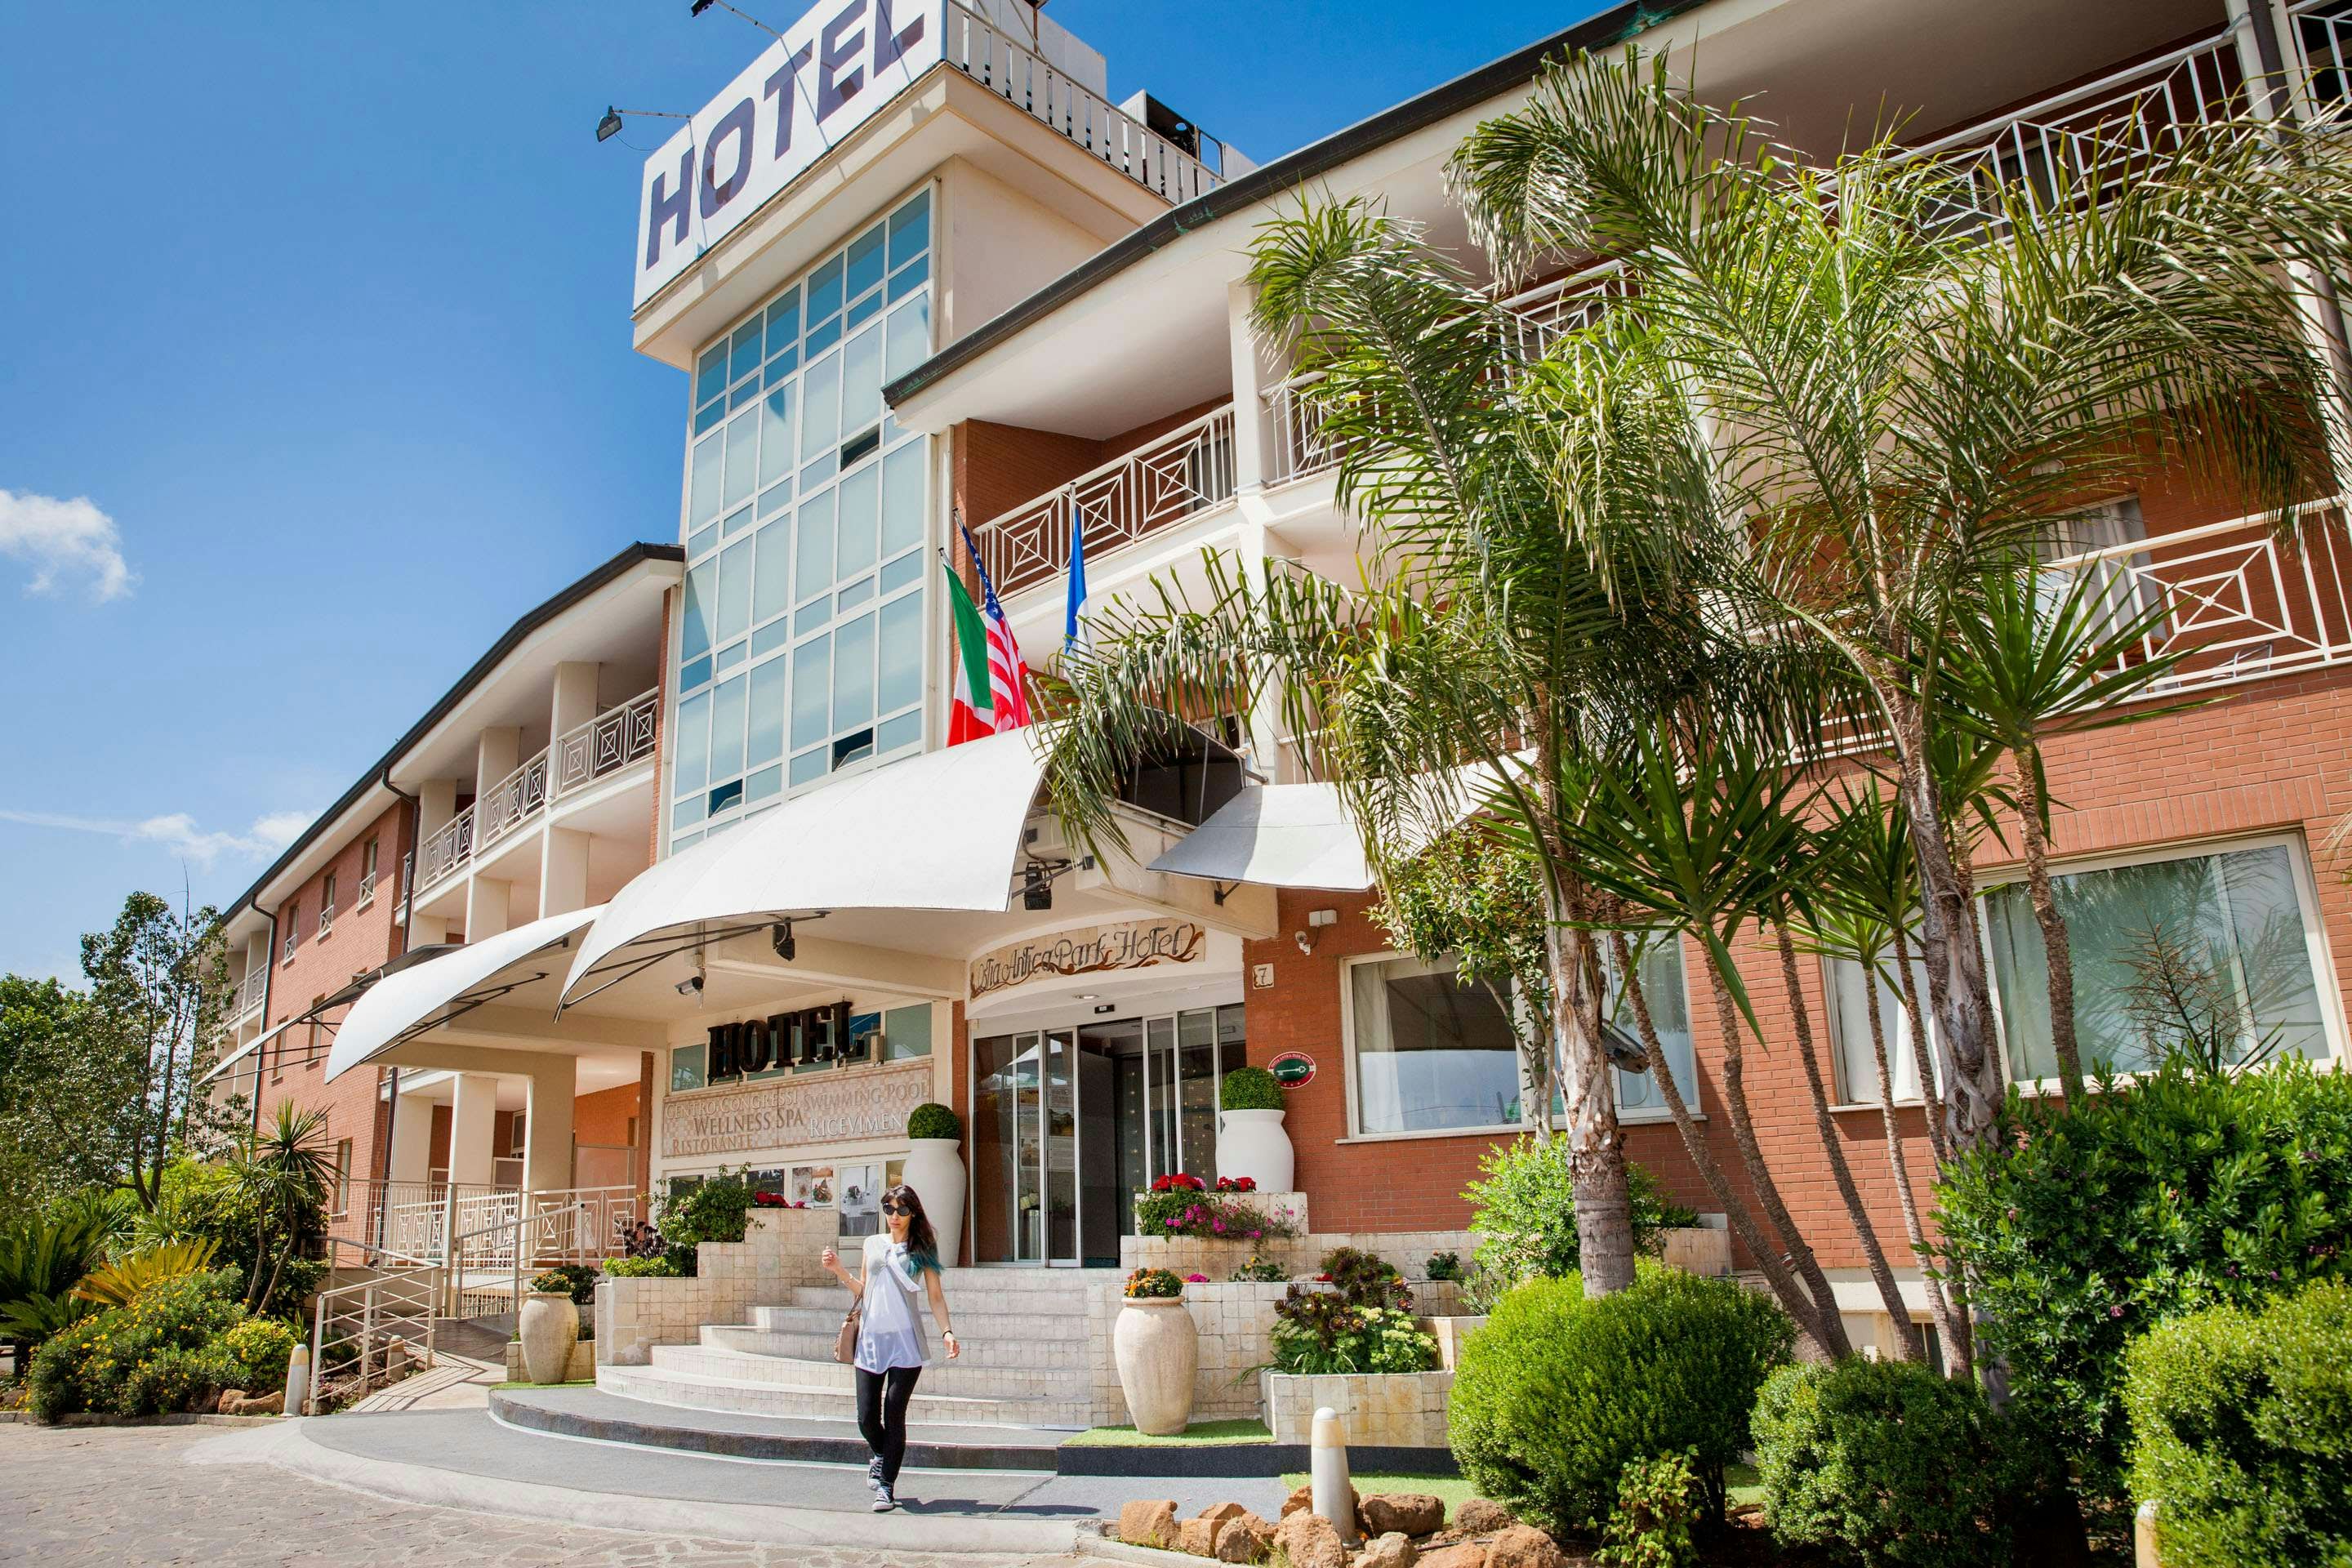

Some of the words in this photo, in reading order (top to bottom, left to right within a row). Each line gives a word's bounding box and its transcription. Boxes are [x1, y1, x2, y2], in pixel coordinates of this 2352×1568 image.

[646, 0, 924, 271] HOTEL
[1054, 933, 1107, 967] Park
[1258, 967, 1267, 984] 7
[706, 1000, 866, 1078] HOTEL
[666, 1102, 716, 1120] CENTRO
[719, 1090, 799, 1113] CONGRESSI
[804, 1087, 882, 1111] SWIMMING
[887, 1081, 929, 1102] POOL
[694, 1111, 771, 1137] WELLNESS
[777, 1107, 804, 1129] SPA
[672, 1134, 754, 1154] RISTORANTE
